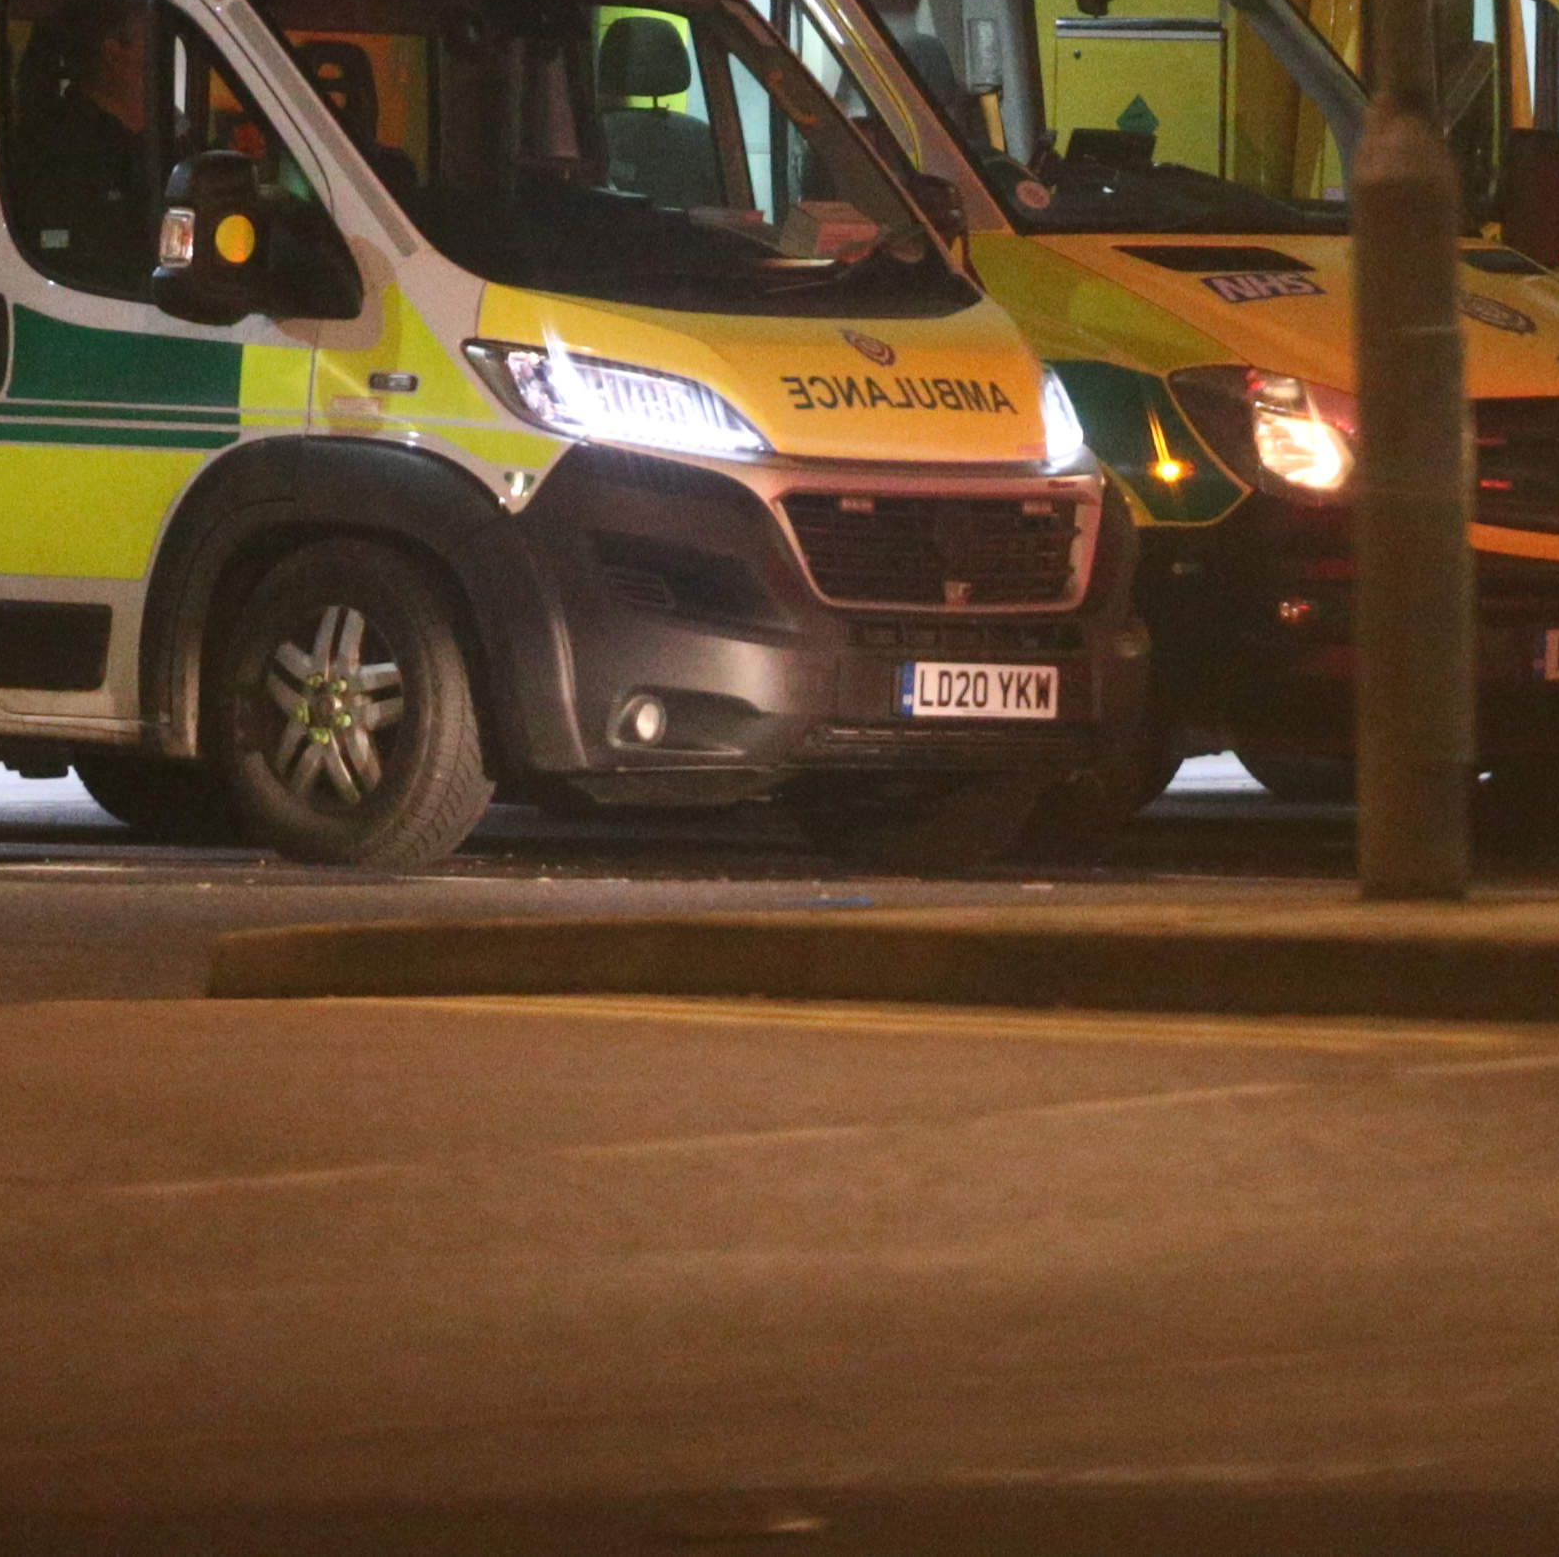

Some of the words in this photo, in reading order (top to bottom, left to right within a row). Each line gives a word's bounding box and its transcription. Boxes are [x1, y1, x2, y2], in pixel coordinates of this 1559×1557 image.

[1212, 272, 1322, 301] NHS
[918, 669, 989, 708] LD20
[998, 671, 1052, 710] YKW
